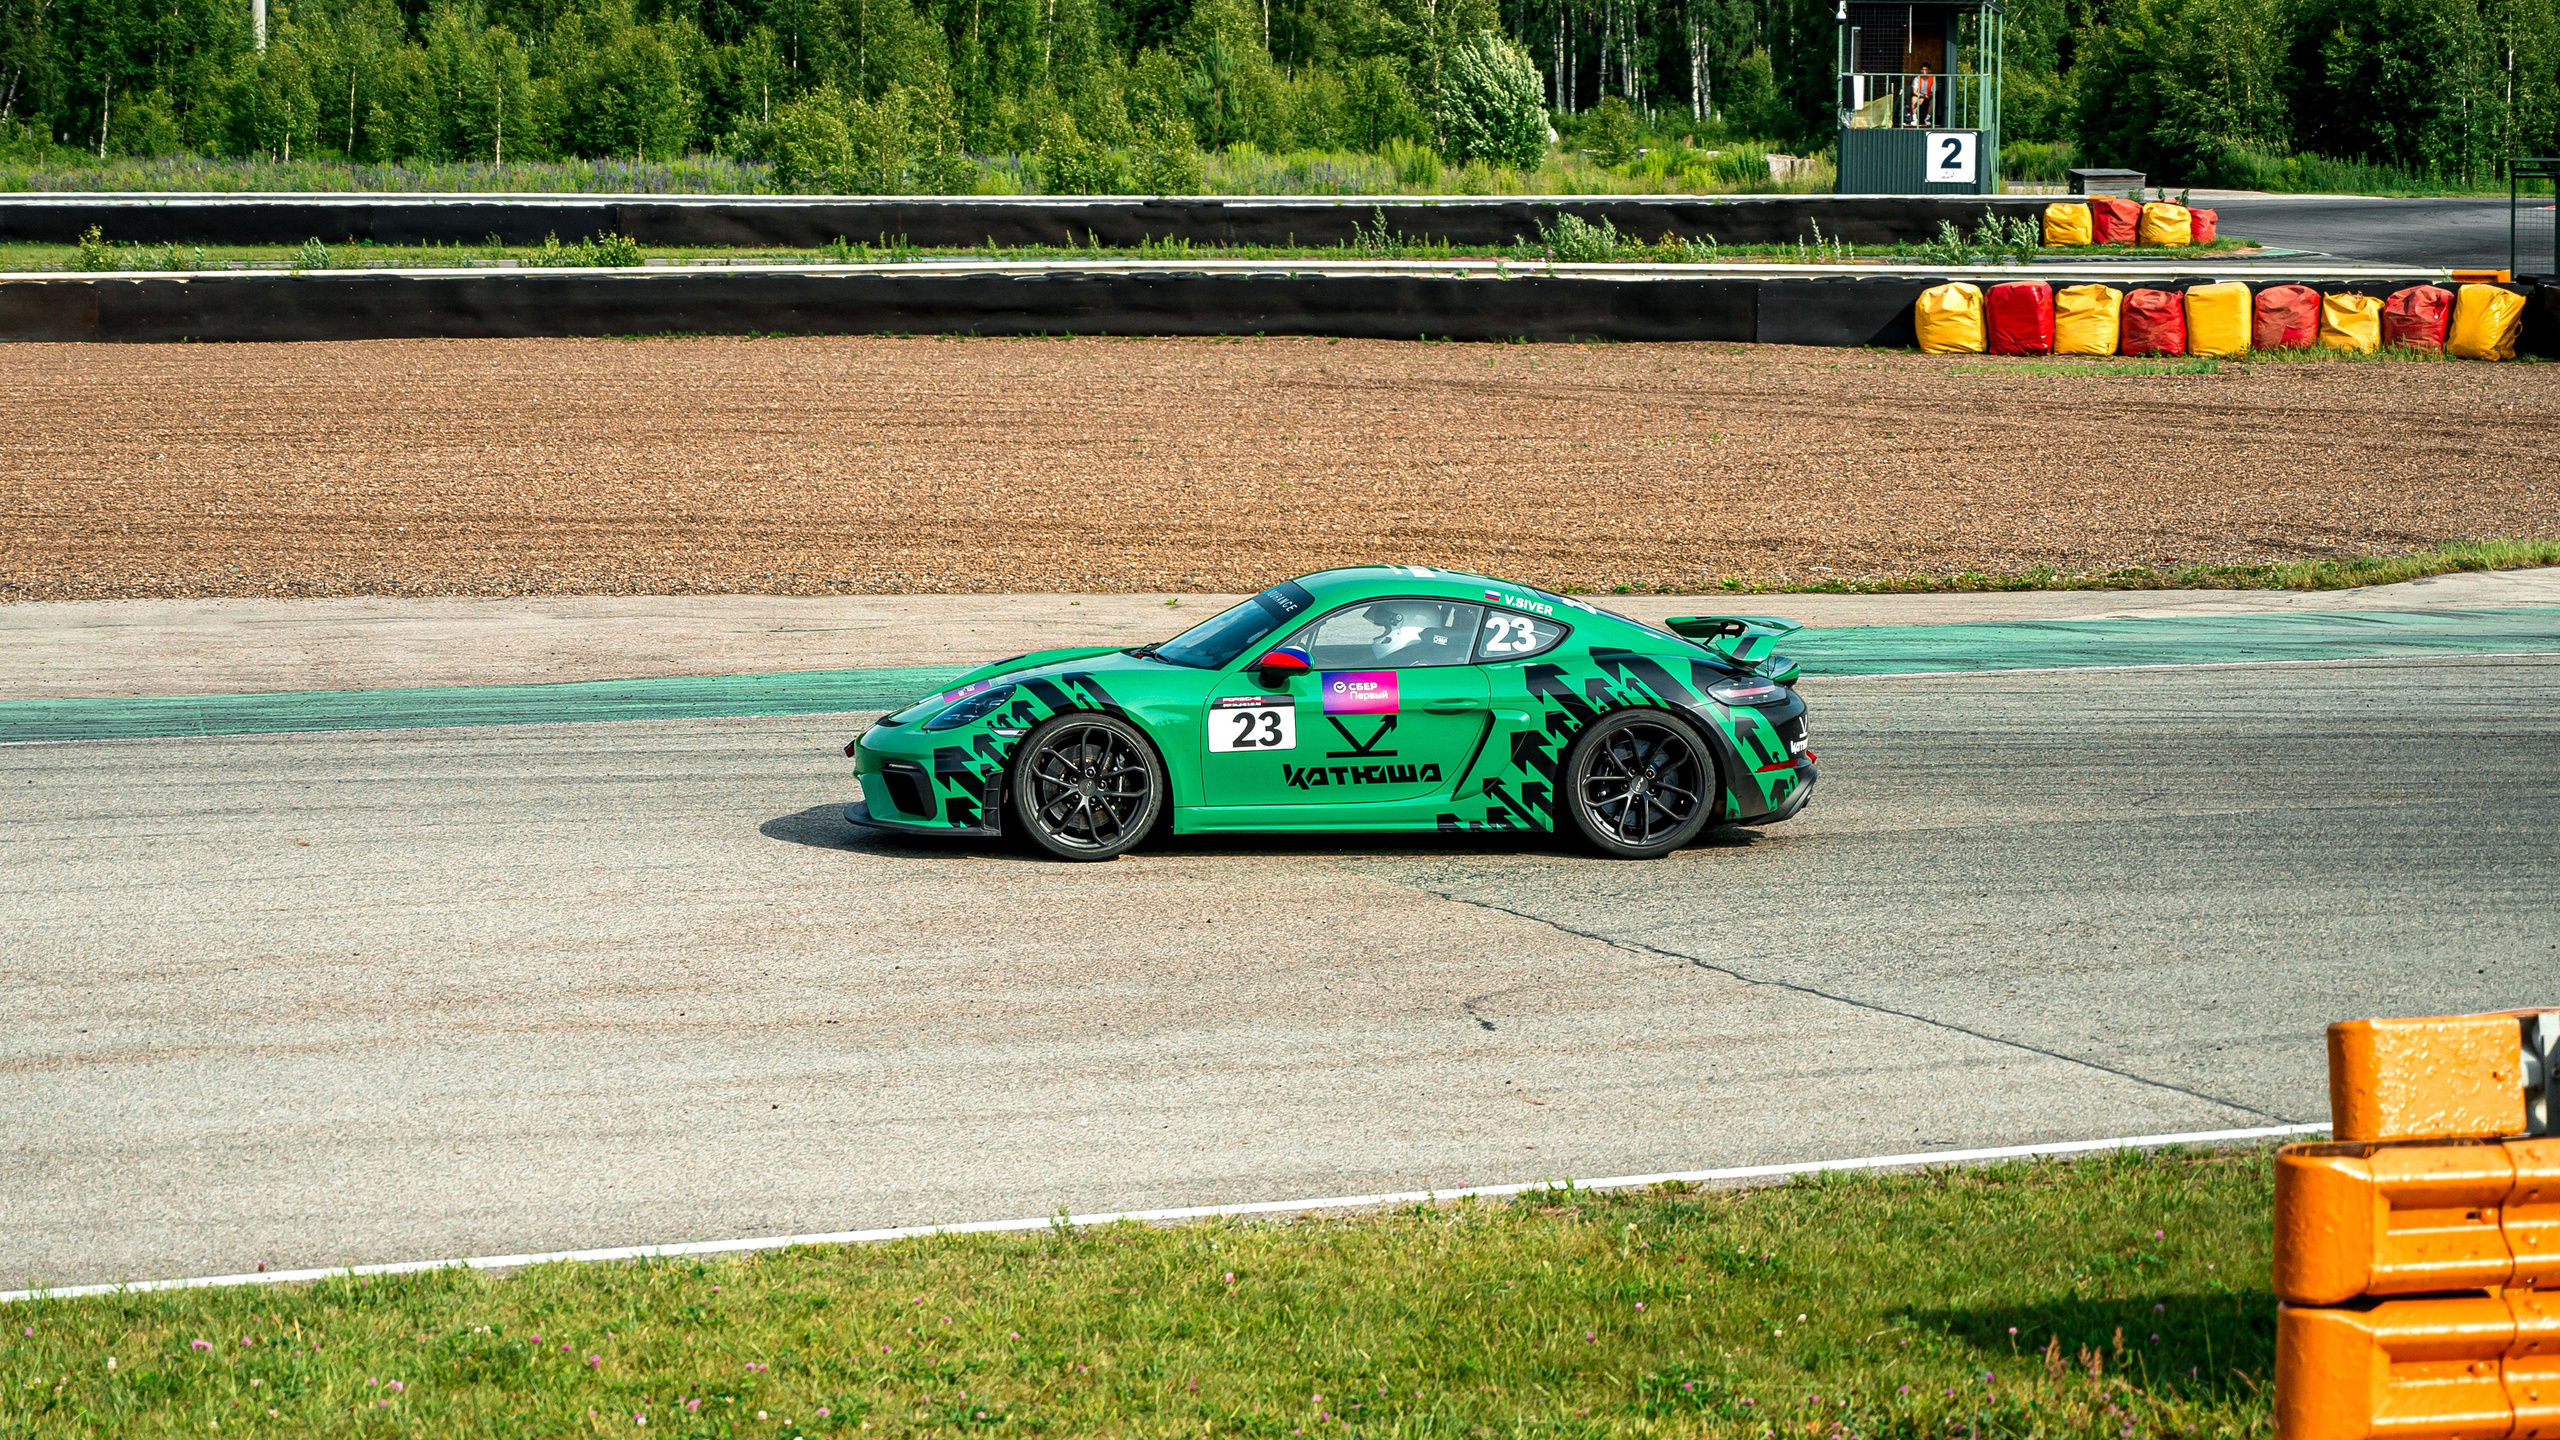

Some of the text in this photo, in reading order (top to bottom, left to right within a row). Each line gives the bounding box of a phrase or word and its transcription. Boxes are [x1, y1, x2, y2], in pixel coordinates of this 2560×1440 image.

[1940, 137, 1962, 169] 2
[1505, 594, 1553, 616] V.SIVER
[1485, 616, 1536, 652] 23
[1348, 682, 1378, 691] СБЕР
[1350, 690, 1388, 701] Первый
[1232, 710, 1283, 748] 23
